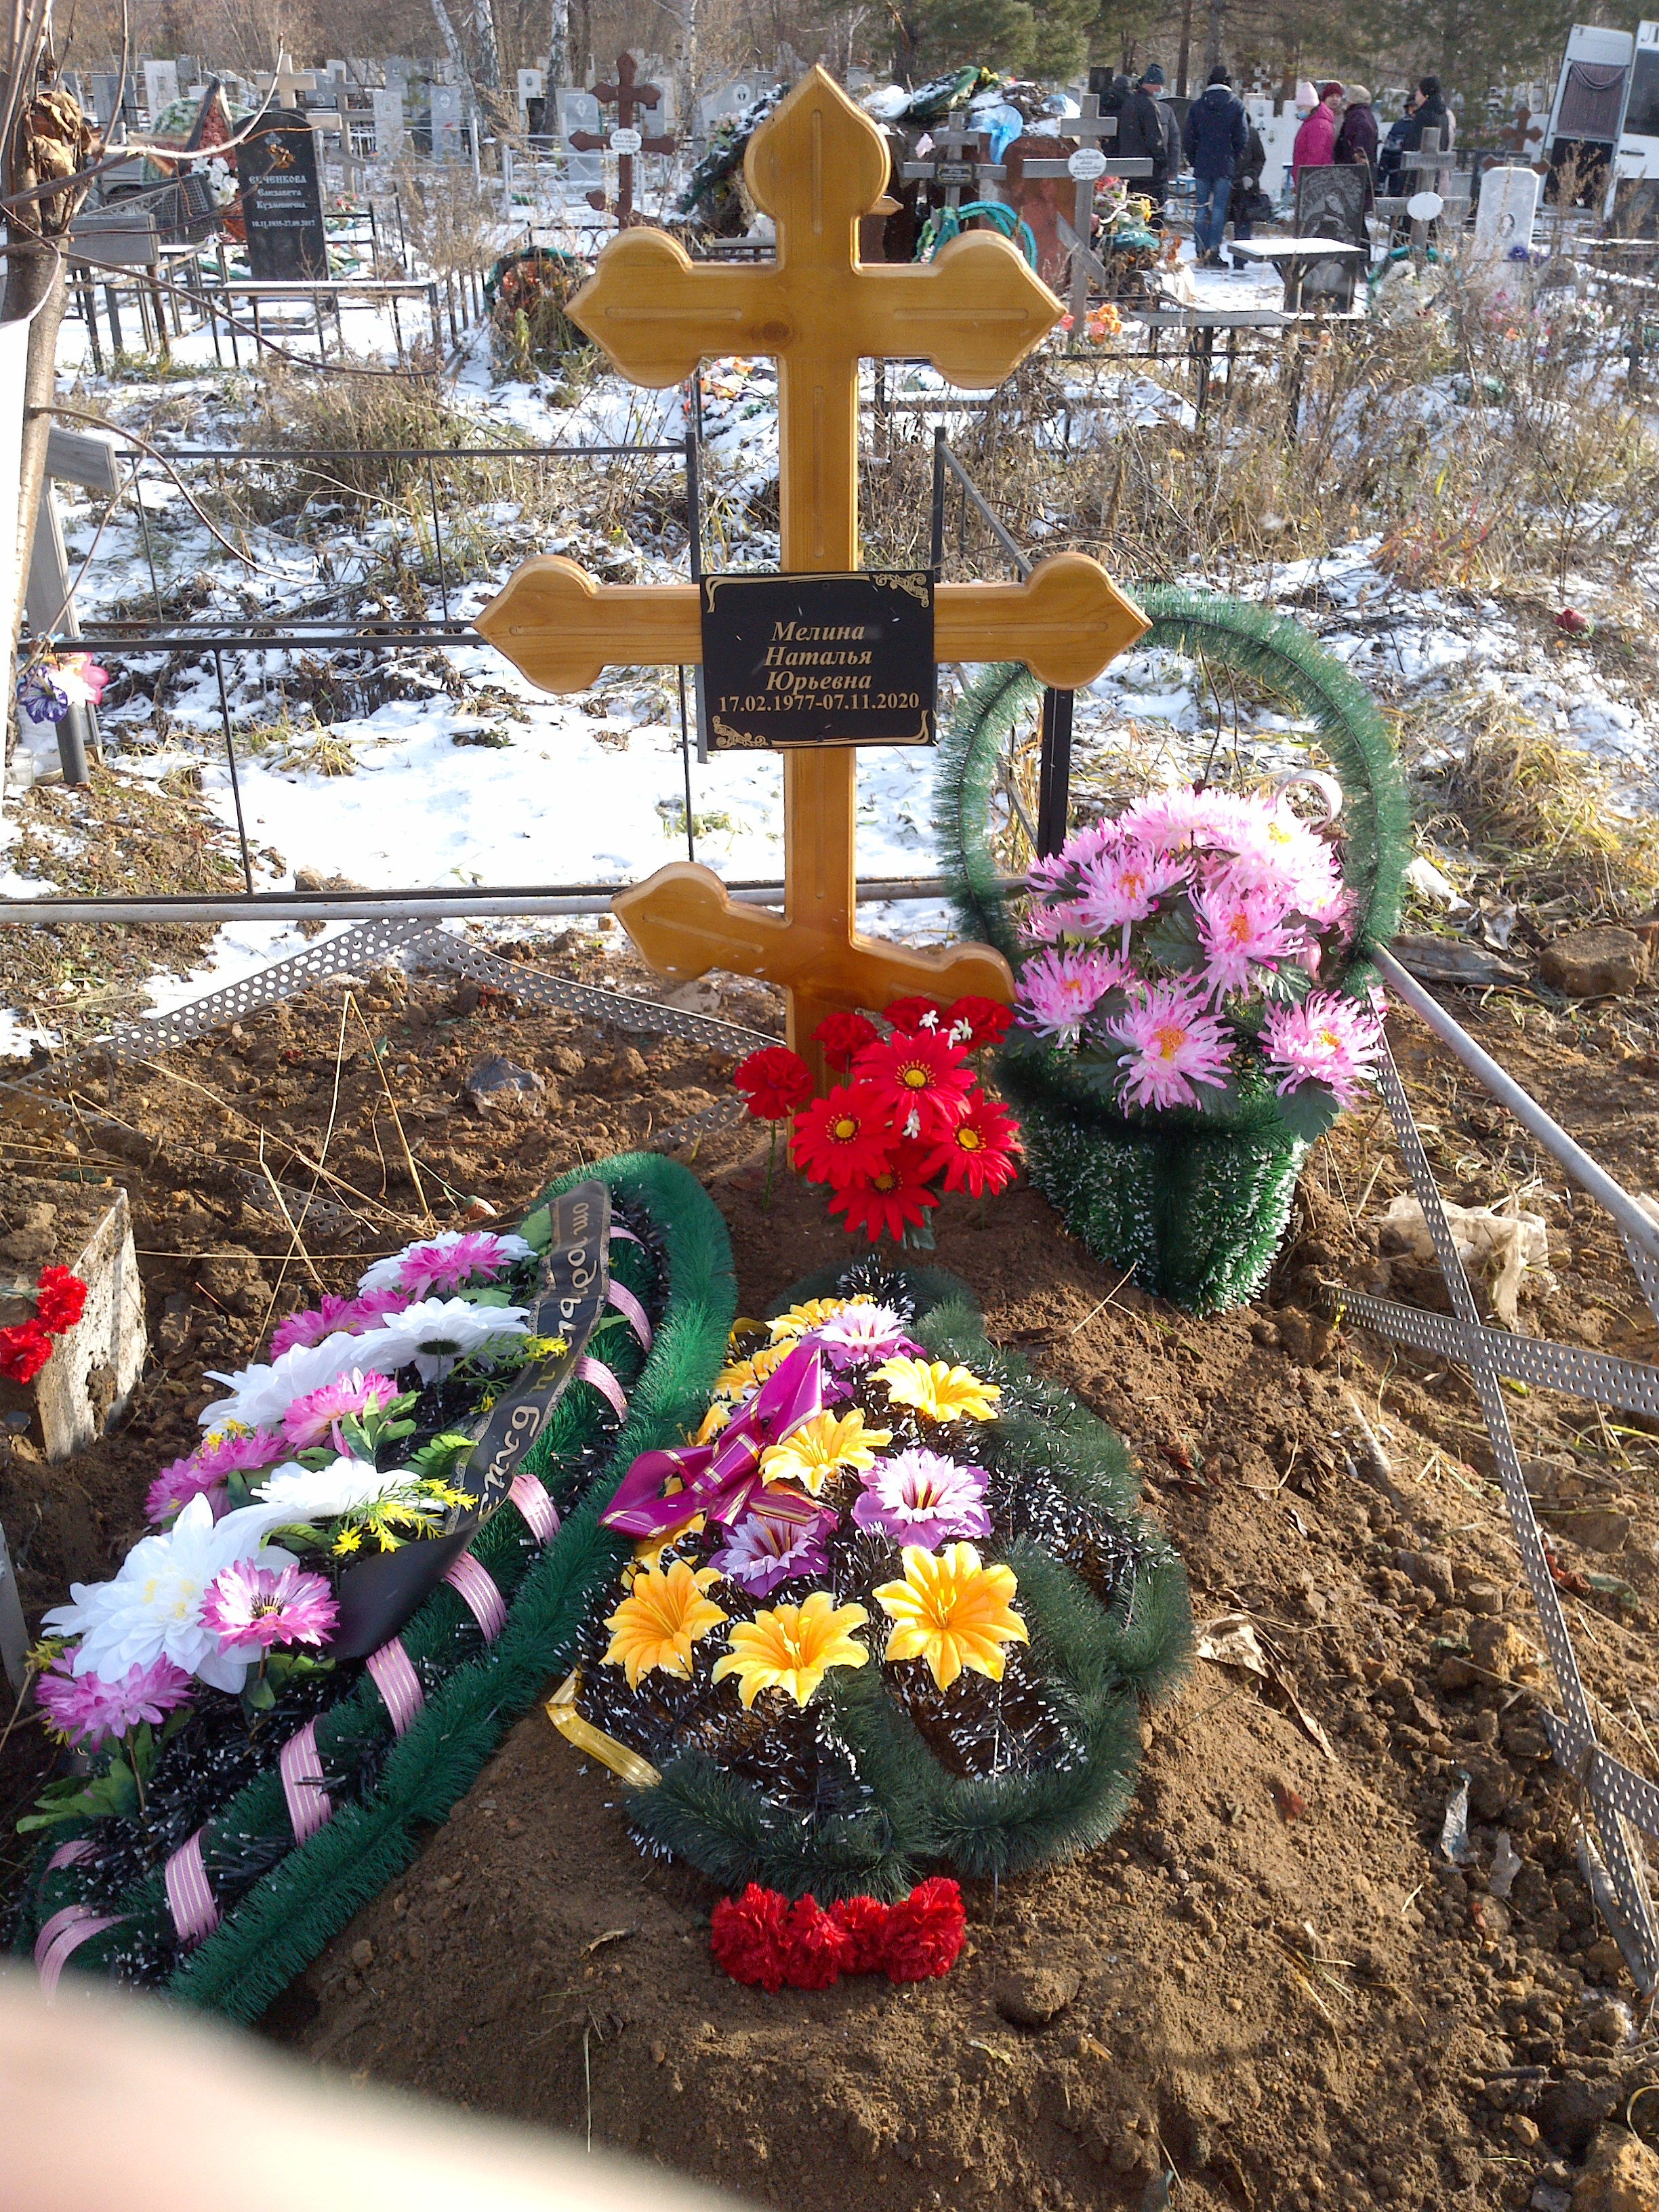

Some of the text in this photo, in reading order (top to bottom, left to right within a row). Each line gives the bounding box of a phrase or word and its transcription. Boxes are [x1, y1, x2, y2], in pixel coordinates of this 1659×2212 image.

[771, 621, 865, 642] Мелина
[764, 645, 873, 667] Наталья
[765, 670, 872, 695] Юрьевна
[719, 693, 920, 713] 17.02.1977-07.11.2020
